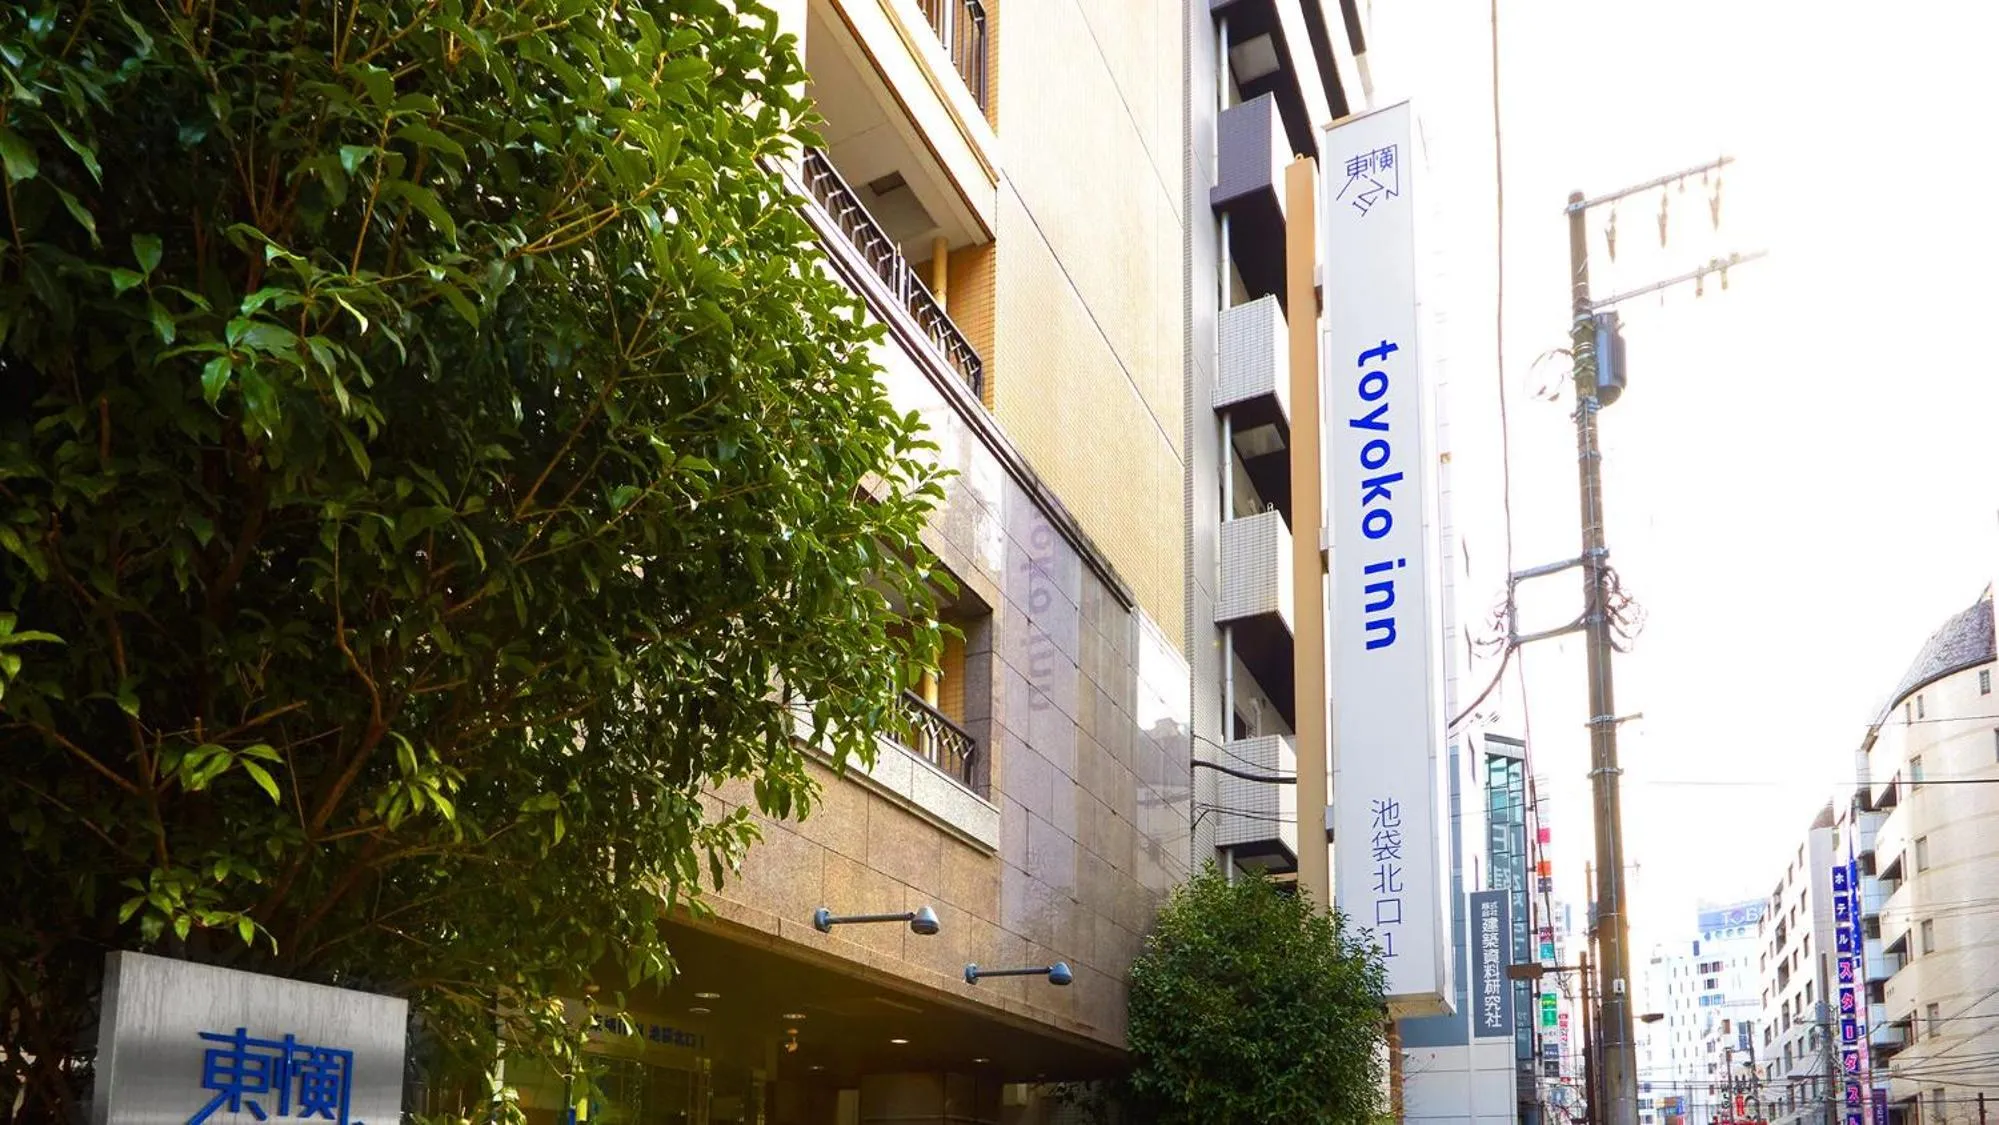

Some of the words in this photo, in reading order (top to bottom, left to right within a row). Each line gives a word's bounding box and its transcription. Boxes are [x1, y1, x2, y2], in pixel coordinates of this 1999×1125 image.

[1349, 340, 1403, 539] toyoko
[1364, 558, 1406, 650] inn
[1371, 797, 1403, 958] 池袋北口1
